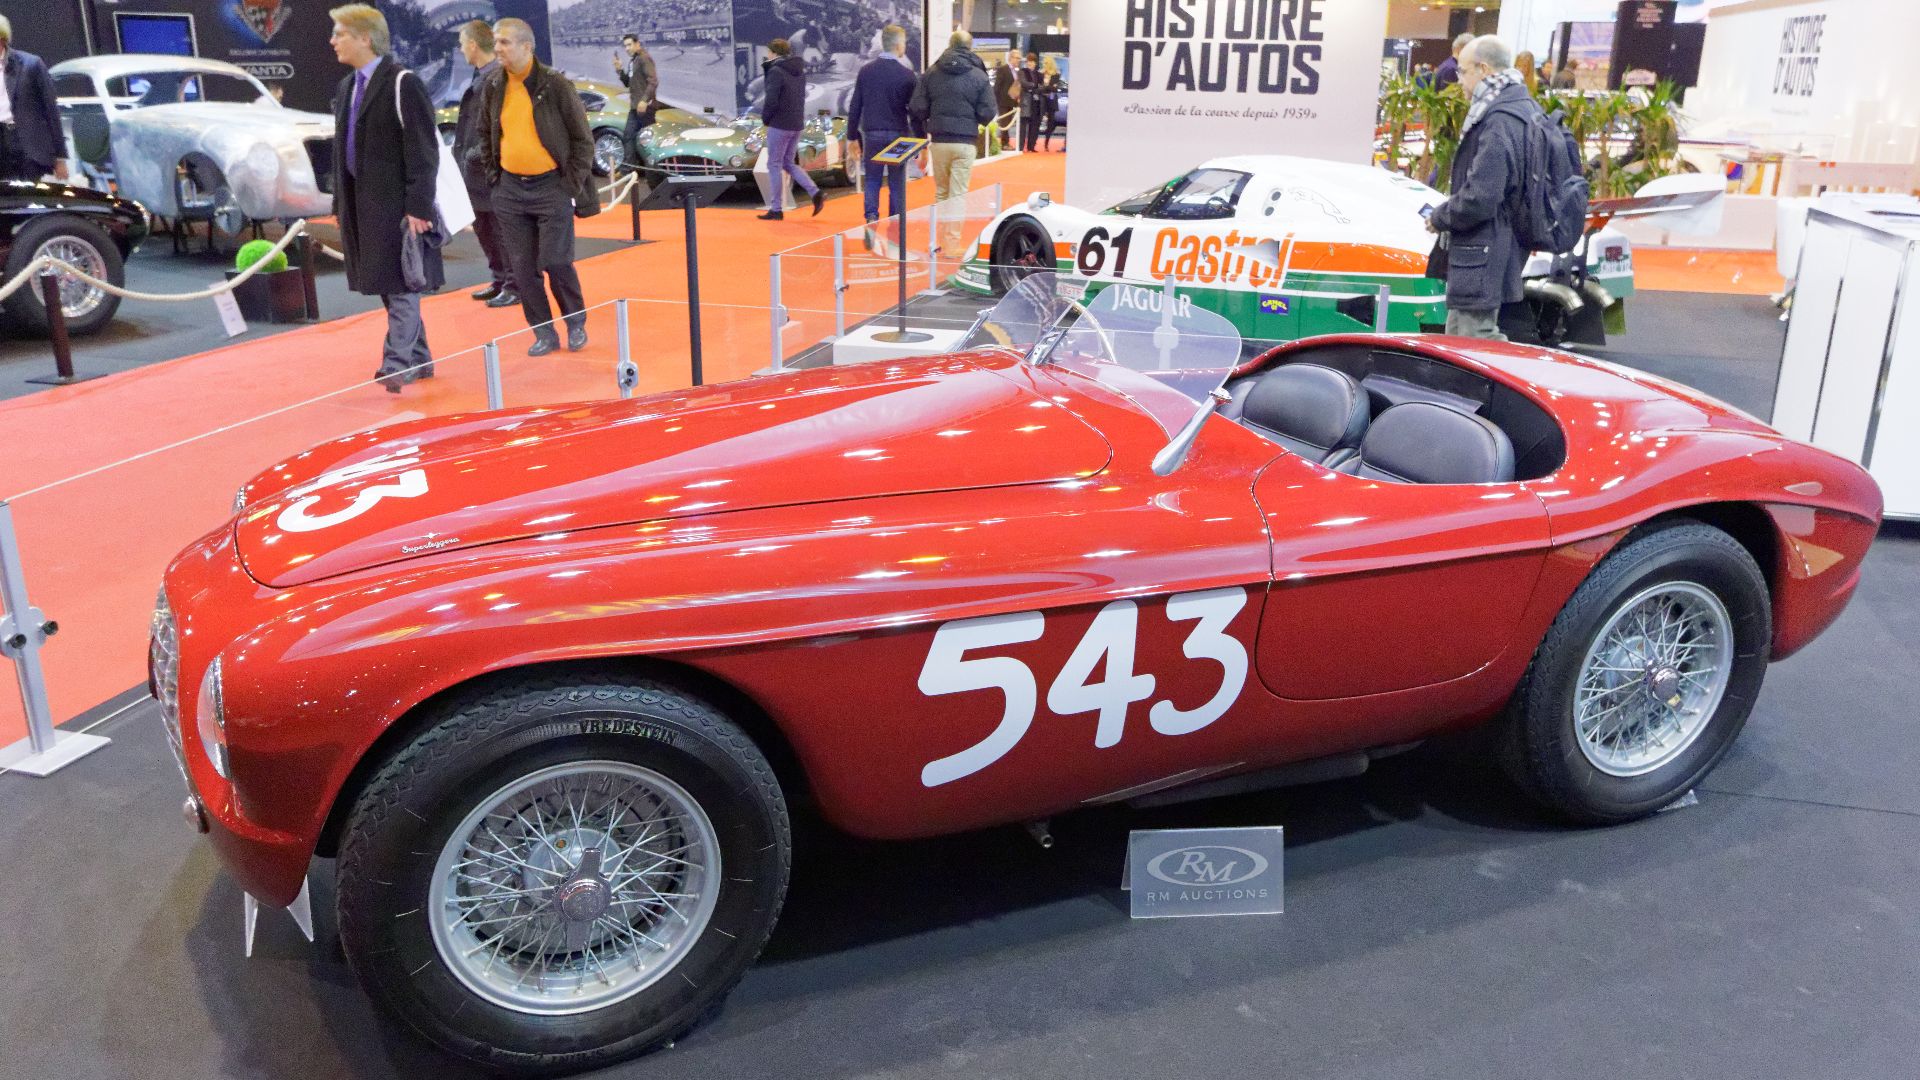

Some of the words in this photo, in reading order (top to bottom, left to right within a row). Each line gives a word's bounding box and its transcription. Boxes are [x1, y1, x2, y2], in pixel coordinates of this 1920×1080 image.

[1125, 0, 1325, 41] HISTOIRE
[1780, 14, 1826, 54] HISTOIRE
[1122, 41, 1322, 95] D'AUTOS
[1773, 56, 1819, 97] D'AUTOS
[1174, 105, 1187, 116] de
[1189, 105, 1202, 117] la
[1204, 108, 1239, 118] course
[1242, 107, 1278, 121] depuis
[1077, 226, 1134, 278] 61
[1150, 227, 1295, 288] Castrol
[401, 537, 460, 554] Superleggera
[918, 587, 1248, 788] 543
[579, 718, 679, 745] VREDESTEIN
[1174, 851, 1238, 882] RM
[1146, 891, 1170, 902] RM
[1179, 888, 1269, 902] AUCTIONS
